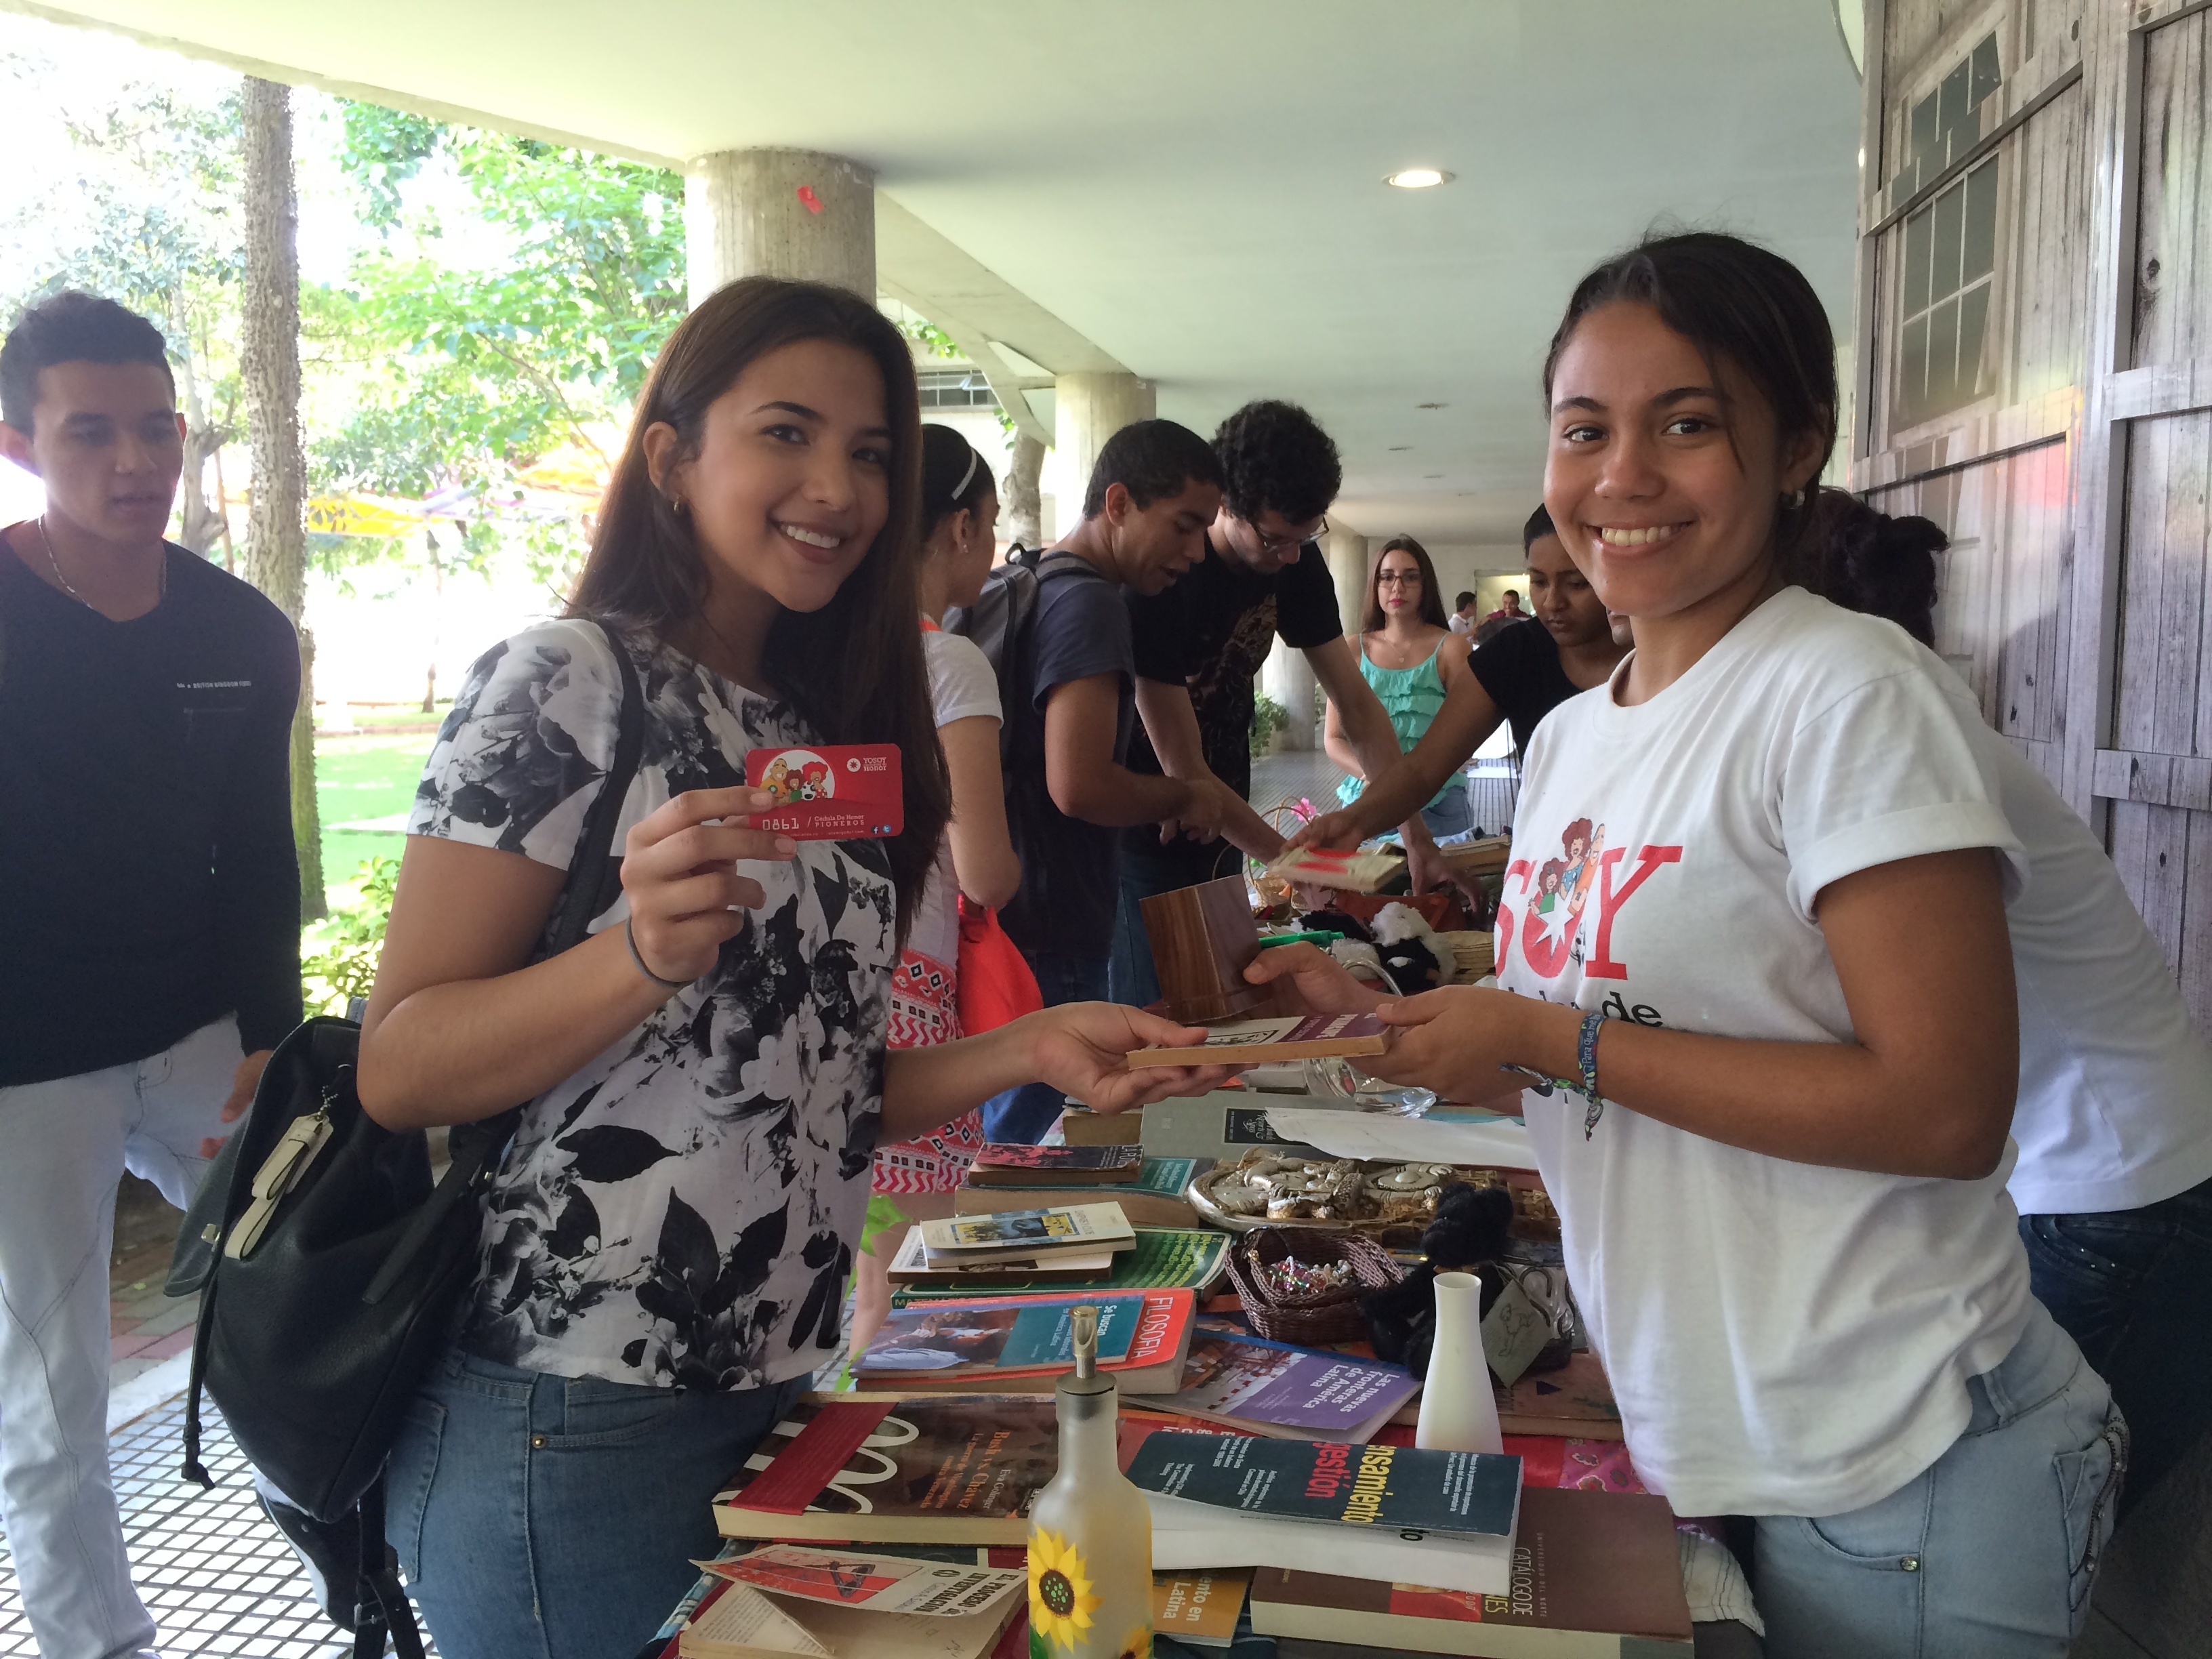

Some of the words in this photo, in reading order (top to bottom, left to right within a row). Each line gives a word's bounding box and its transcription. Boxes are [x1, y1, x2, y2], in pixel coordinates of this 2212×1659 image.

[762, 818, 799, 830] 0861
[815, 819, 865, 827] PIONEROS
[1602, 991, 1663, 1027] de
[1582, 1047, 1593, 1064] Para
[1104, 1305, 1118, 1313] Se
[1097, 1314, 1115, 1336] buscan
[1131, 1297, 1174, 1359] FILOSOFIA
[1310, 1364, 1349, 1387] Latina
[1345, 1368, 1364, 1378] de
[1375, 1374, 1400, 1387] Las
[1302, 1378, 1351, 1408] América
[1331, 1370, 1383, 1404] fronteras
[1340, 1387, 1380, 1412] nuevas
[985, 1431, 1010, 1455] Bush
[996, 1469, 1012, 1481] Eva
[1304, 1442, 1351, 1498] gestión
[957, 1473, 989, 1509] Chávez
[982, 1482, 1004, 1509] Golinger
[1536, 1532, 1544, 1576] UNIVERSIDAD
[1512, 1547, 1535, 1601] CATÁLOGO
[914, 1573, 991, 1613] INVESTIGACION
[958, 1582, 1007, 1607] PROCESO
[1162, 1582, 1191, 1619] Latina
[1186, 1607, 1202, 1622] en
[1513, 1602, 1533, 1616] DE
[1539, 1597, 1547, 1617] NORTE
